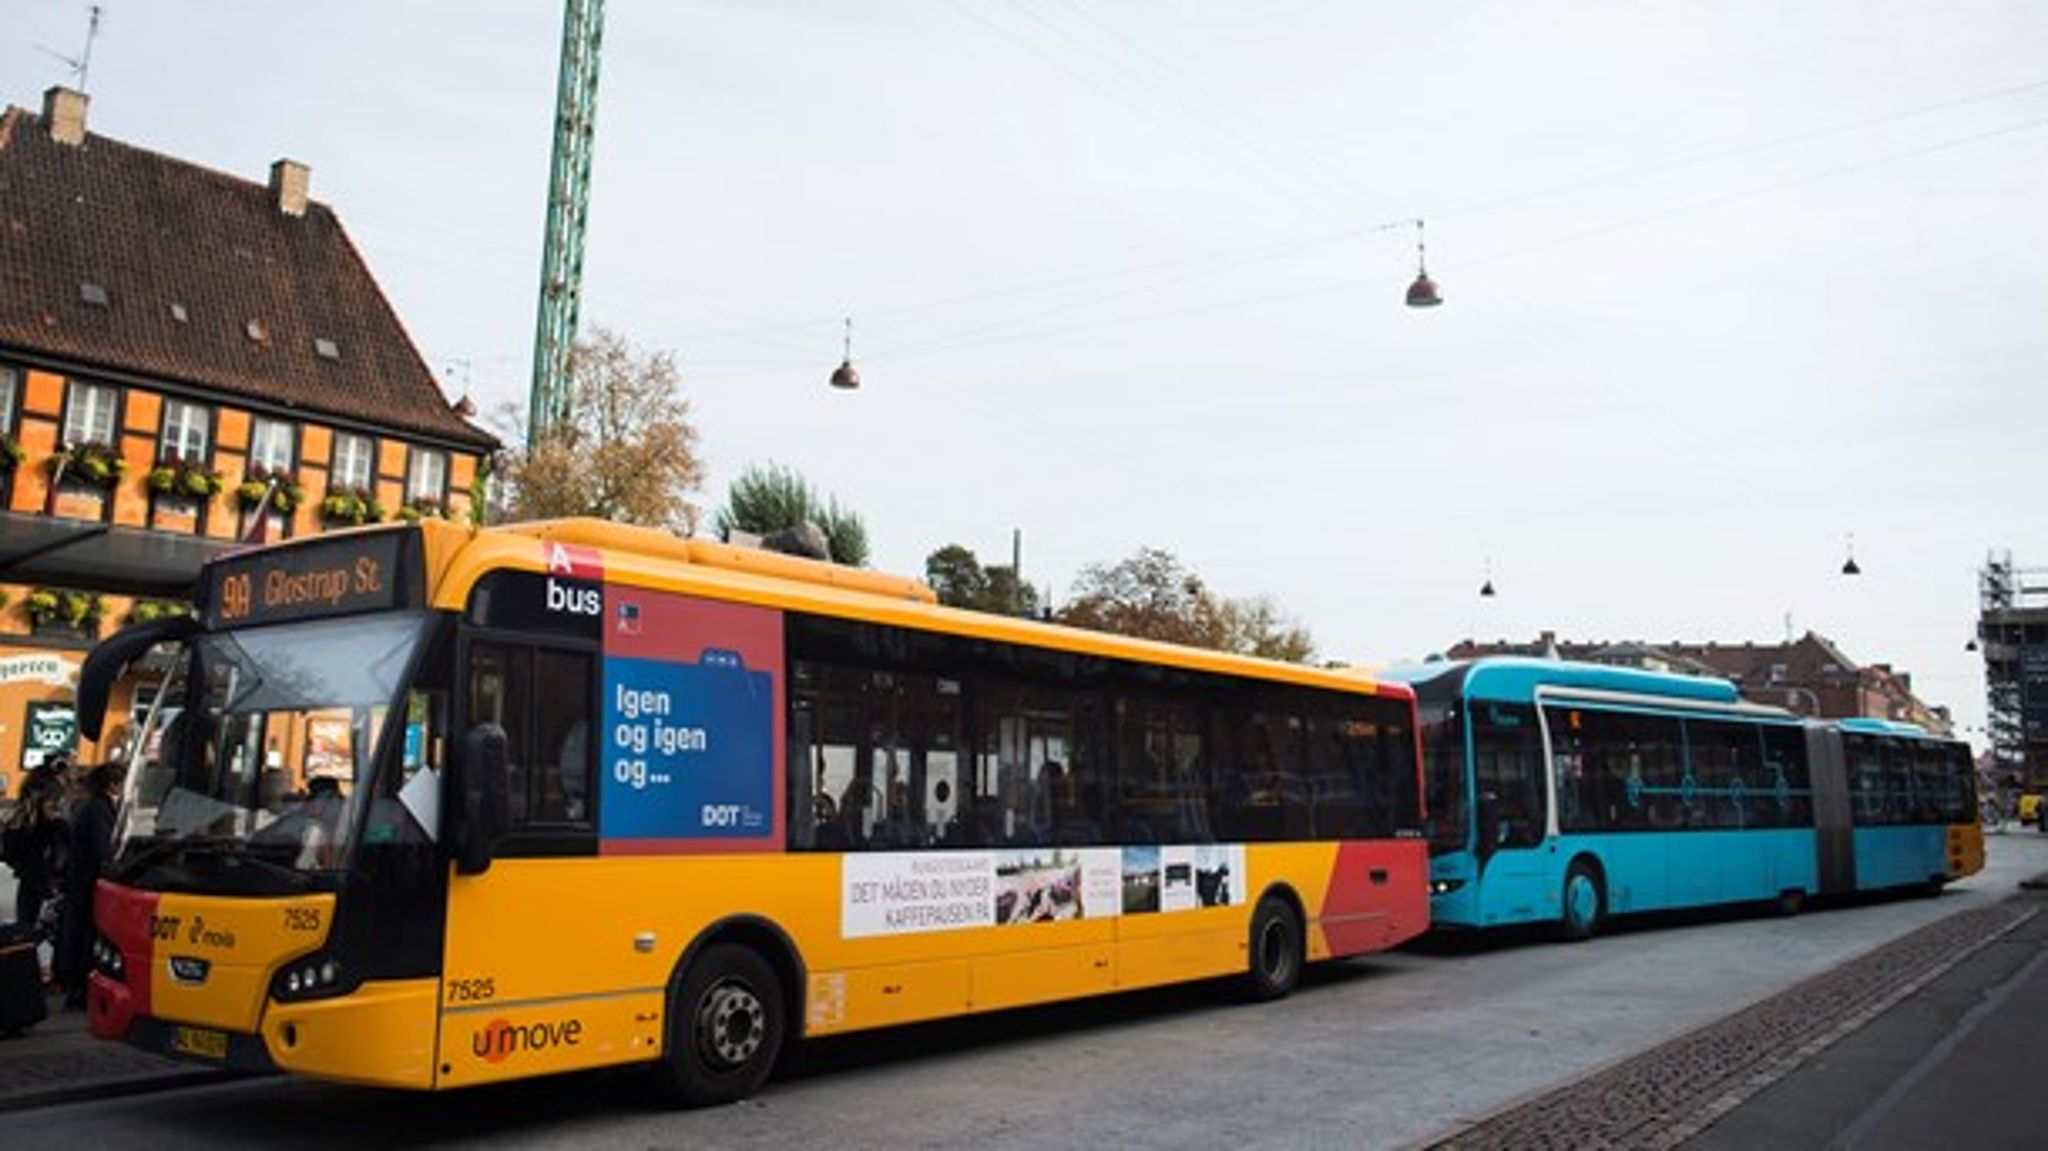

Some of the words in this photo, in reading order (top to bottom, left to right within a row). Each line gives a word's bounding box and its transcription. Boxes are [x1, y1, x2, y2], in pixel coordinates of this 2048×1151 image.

[550, 544, 573, 573] A
[264, 569, 348, 606] Glostrup
[547, 578, 602, 616] bus
[616, 684, 670, 719] Igen
[615, 723, 649, 753] og
[654, 718, 706, 756] igen
[701, 804, 741, 827] DOT
[851, 882, 879, 905] DET
[284, 908, 321, 932] 7525
[447, 977, 495, 1001] 7525
